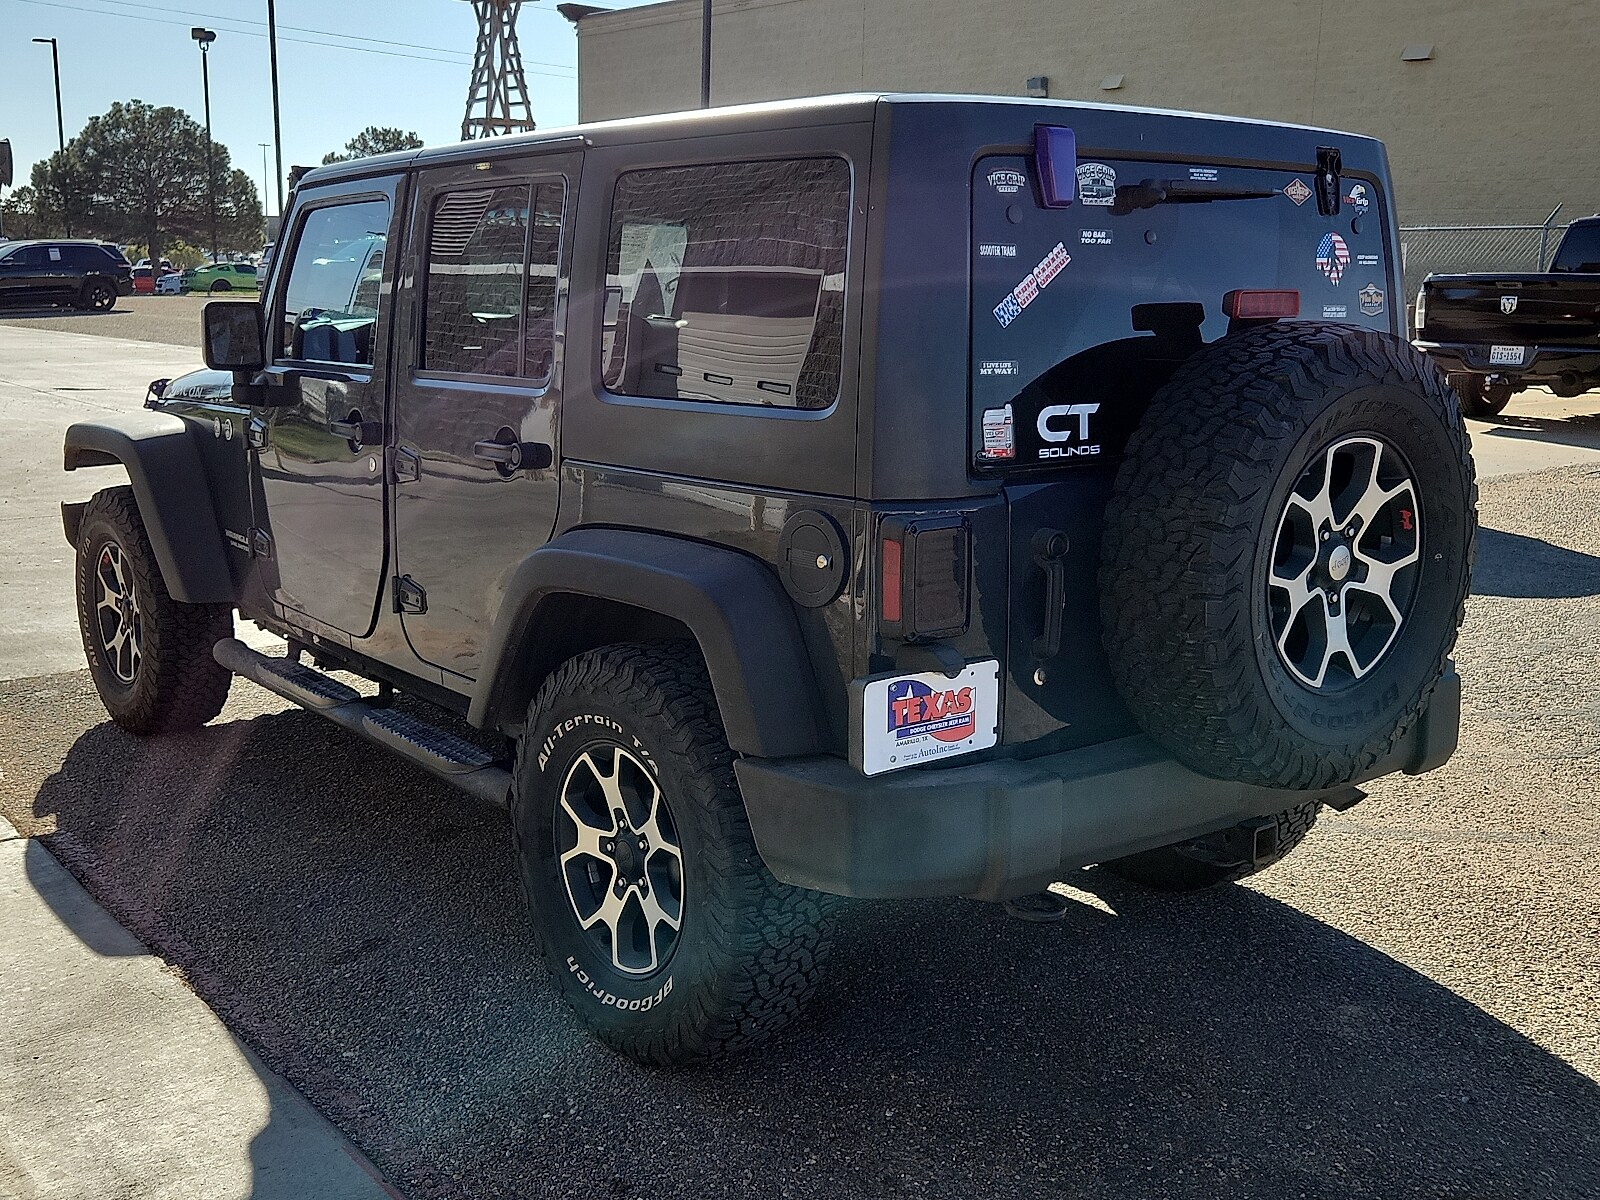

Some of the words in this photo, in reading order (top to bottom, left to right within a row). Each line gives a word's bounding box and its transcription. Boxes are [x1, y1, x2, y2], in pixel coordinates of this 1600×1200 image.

[987, 173, 1006, 186] VICE
[1006, 173, 1026, 187] GRIP
[1356, 197, 1369, 207] Grip
[1082, 230, 1092, 238] NO
[1092, 230, 1106, 238] BAR
[979, 244, 1001, 256] SCOOTER
[1001, 245, 1017, 257] TRASH
[170, 385, 204, 398] UBICON
[1036, 403, 1101, 442] CT
[1038, 445, 1101, 459] SOUNDS
[891, 686, 972, 726] TEXAS
[909, 726, 927, 735] DODGE
[958, 716, 970, 724] RAM
[918, 744, 948, 759] AutoInc
[566, 955, 674, 1012] BFGoodrich
